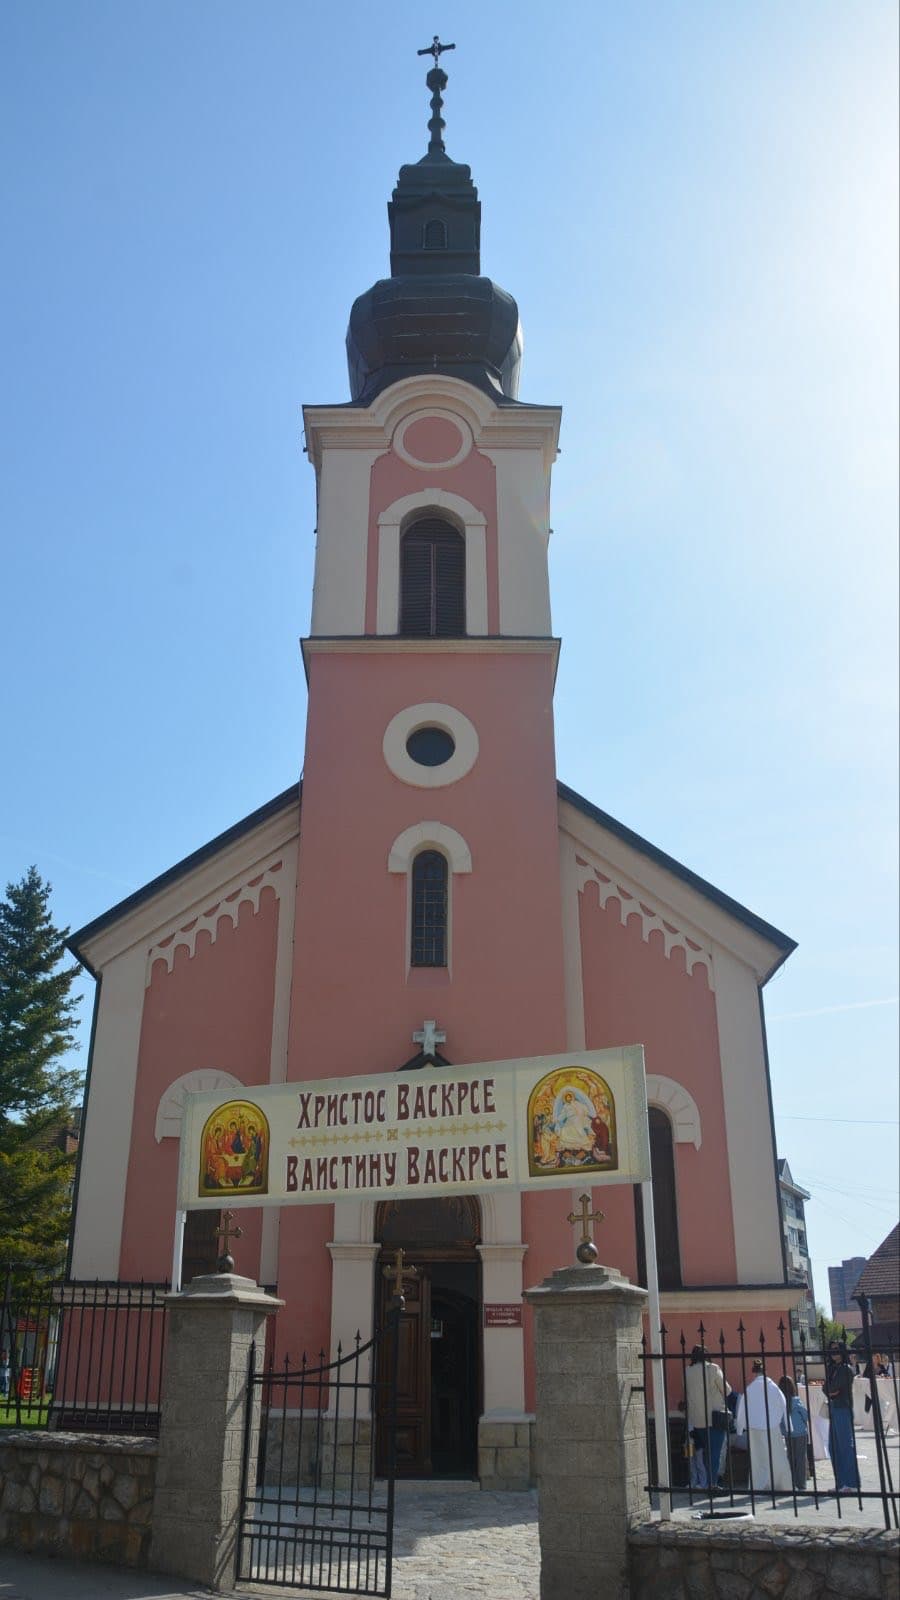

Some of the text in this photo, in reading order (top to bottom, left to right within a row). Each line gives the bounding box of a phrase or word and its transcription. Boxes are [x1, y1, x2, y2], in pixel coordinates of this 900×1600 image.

[297, 1079, 496, 1129] ХРИСТОС ВАСКРСЕ
[286, 1143, 508, 1192] ВАИСТИНУ ВАСКРСЕ
